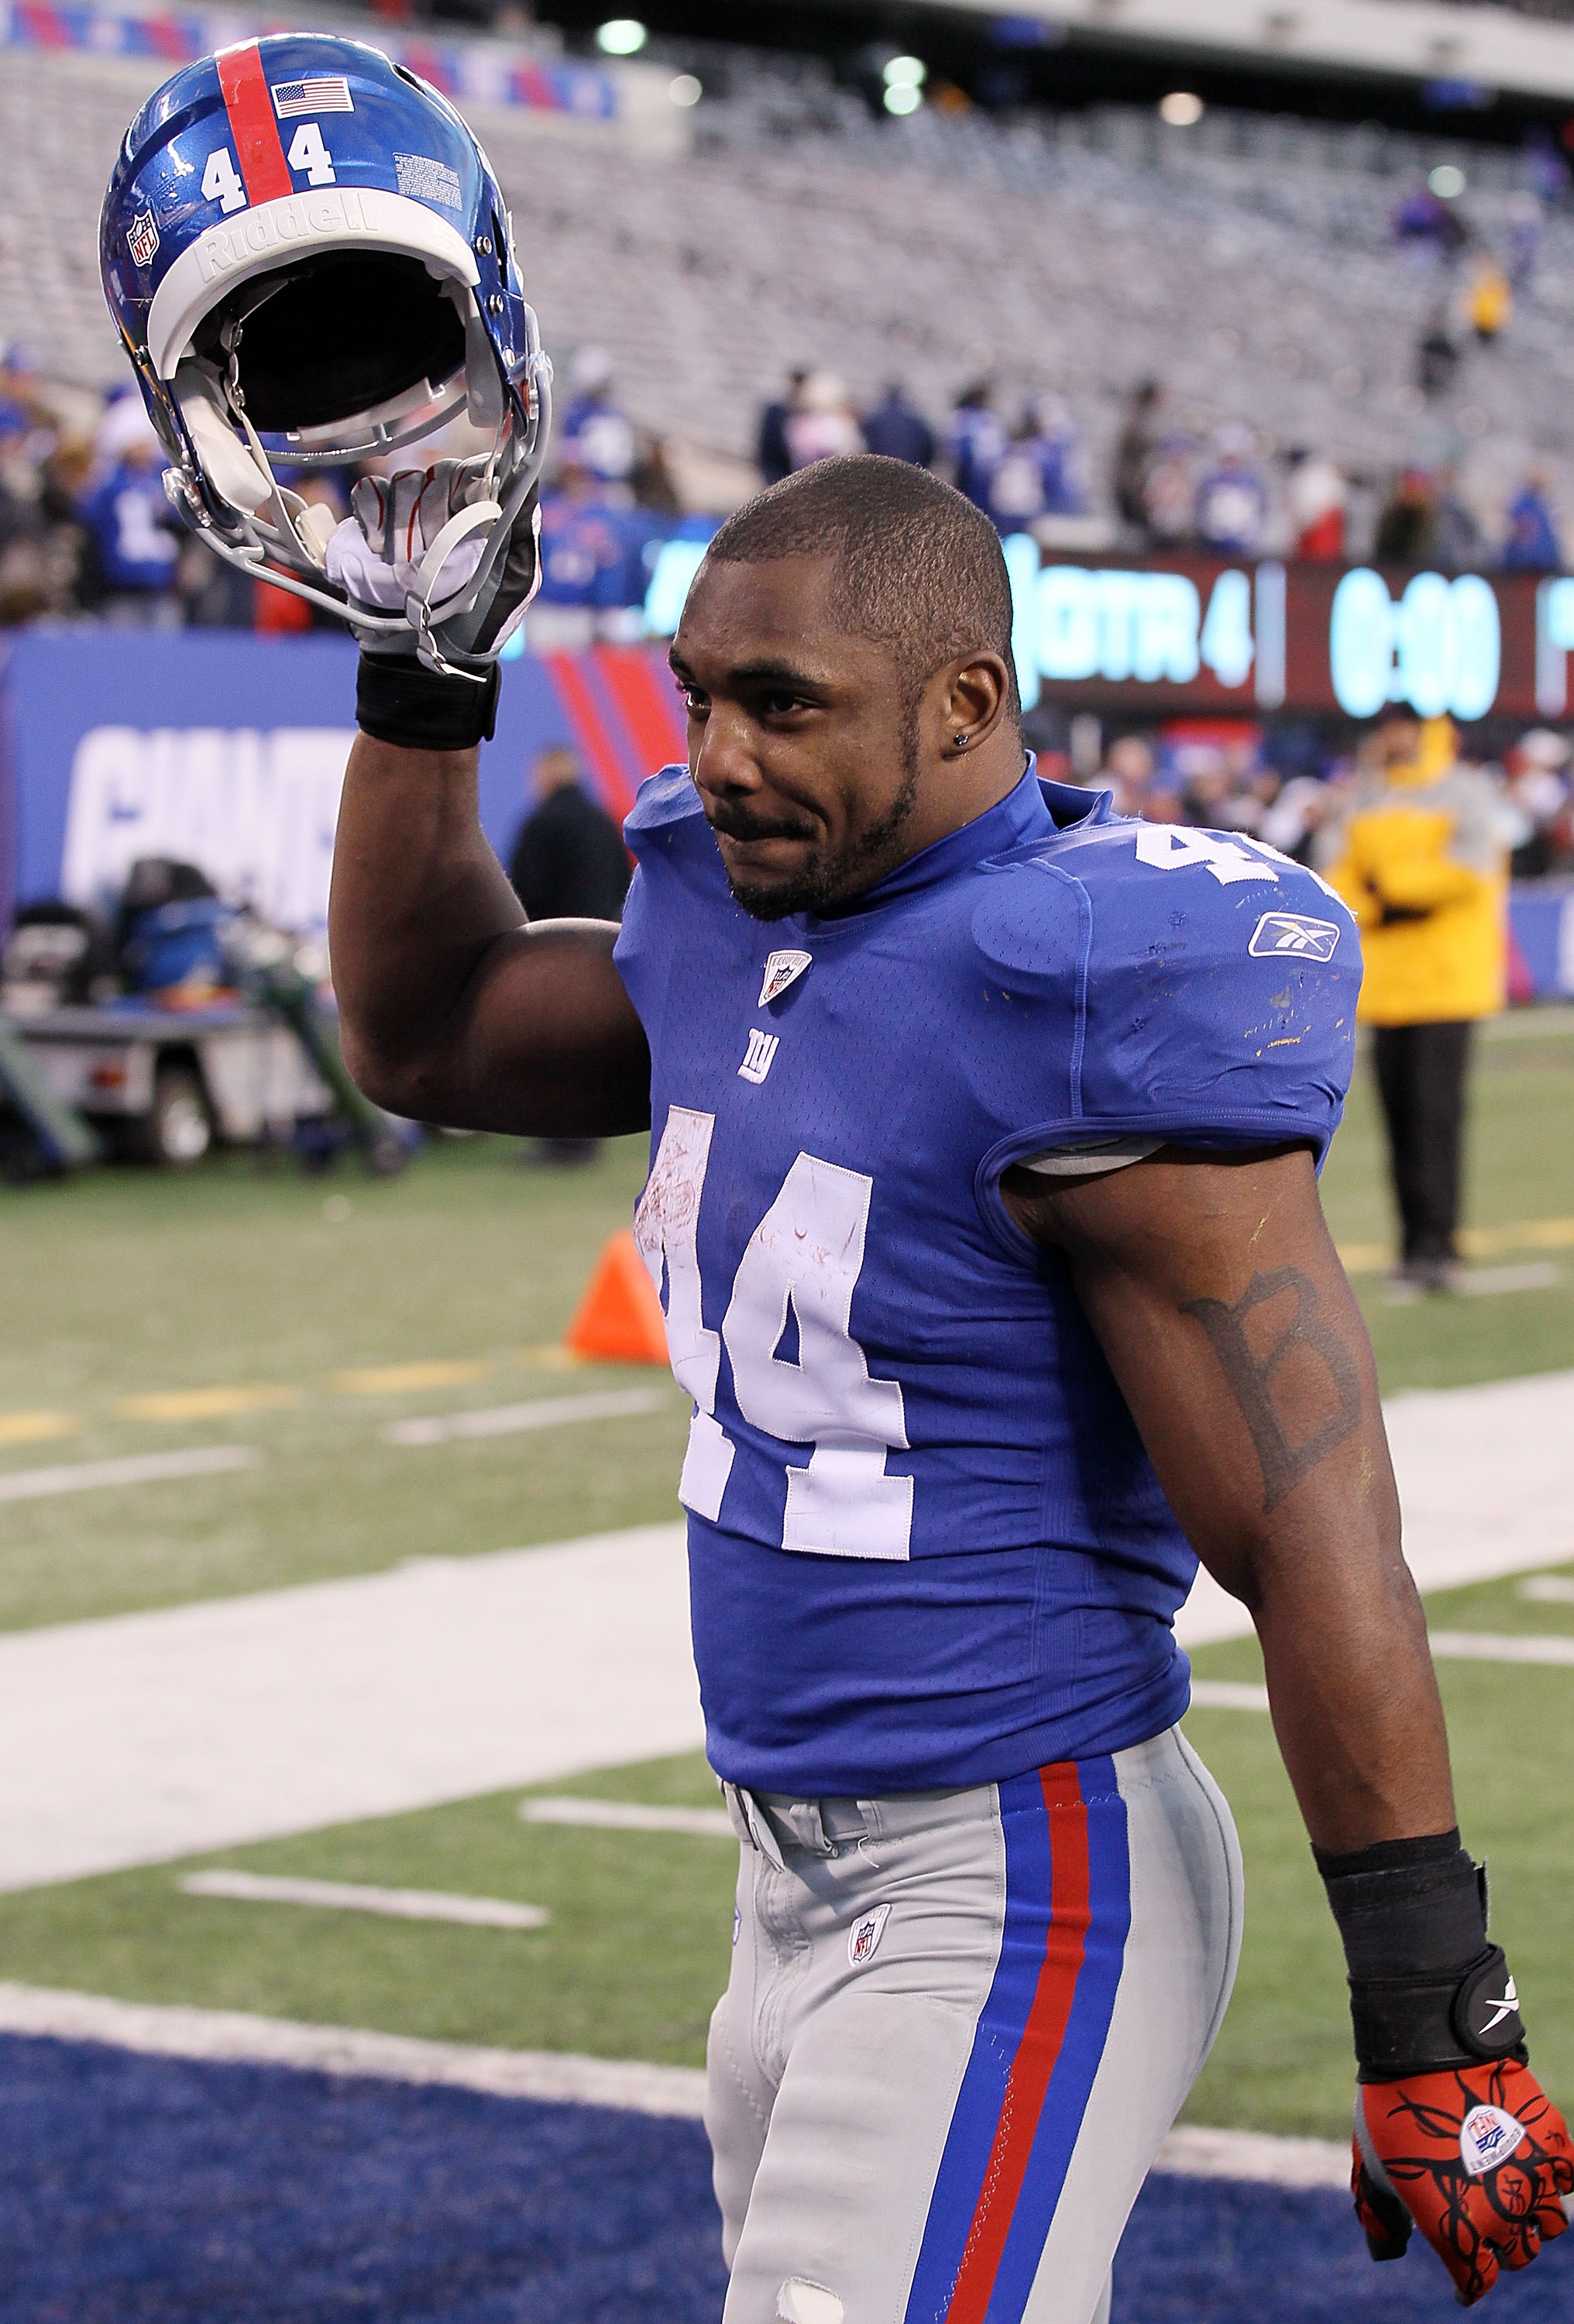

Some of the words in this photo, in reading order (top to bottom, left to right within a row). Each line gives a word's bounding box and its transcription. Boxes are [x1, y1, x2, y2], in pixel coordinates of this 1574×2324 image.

[134, 232, 155, 260] NFL
[194, 192, 379, 284] Riddell
[1200, 569, 1254, 688] 4
[634, 1105, 914, 1560] 44
[1178, 1264, 1362, 1515] B
[854, 1937, 870, 1957] NFL
